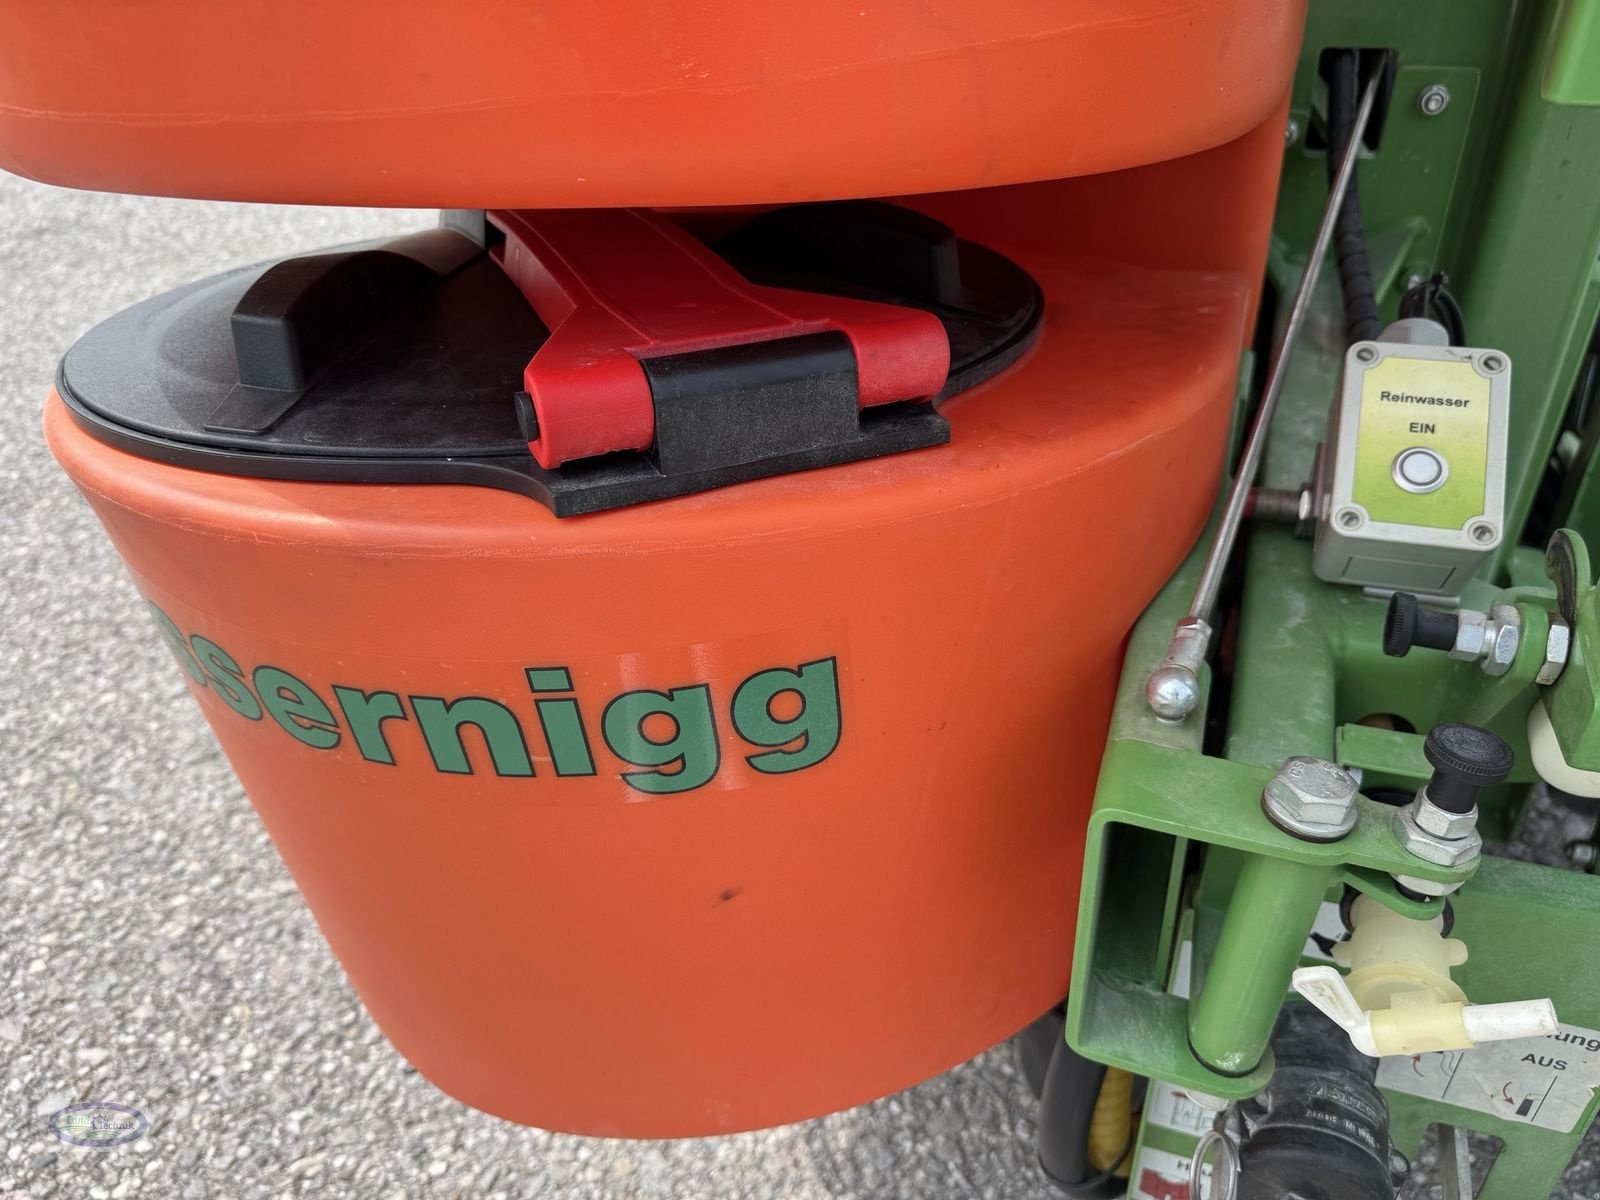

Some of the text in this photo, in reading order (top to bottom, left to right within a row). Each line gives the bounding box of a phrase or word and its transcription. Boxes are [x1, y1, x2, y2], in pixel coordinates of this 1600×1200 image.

[1380, 391, 1470, 408] Reinwasser
[1409, 422, 1436, 435] EIN
[1520, 1053, 1568, 1071] AUS
